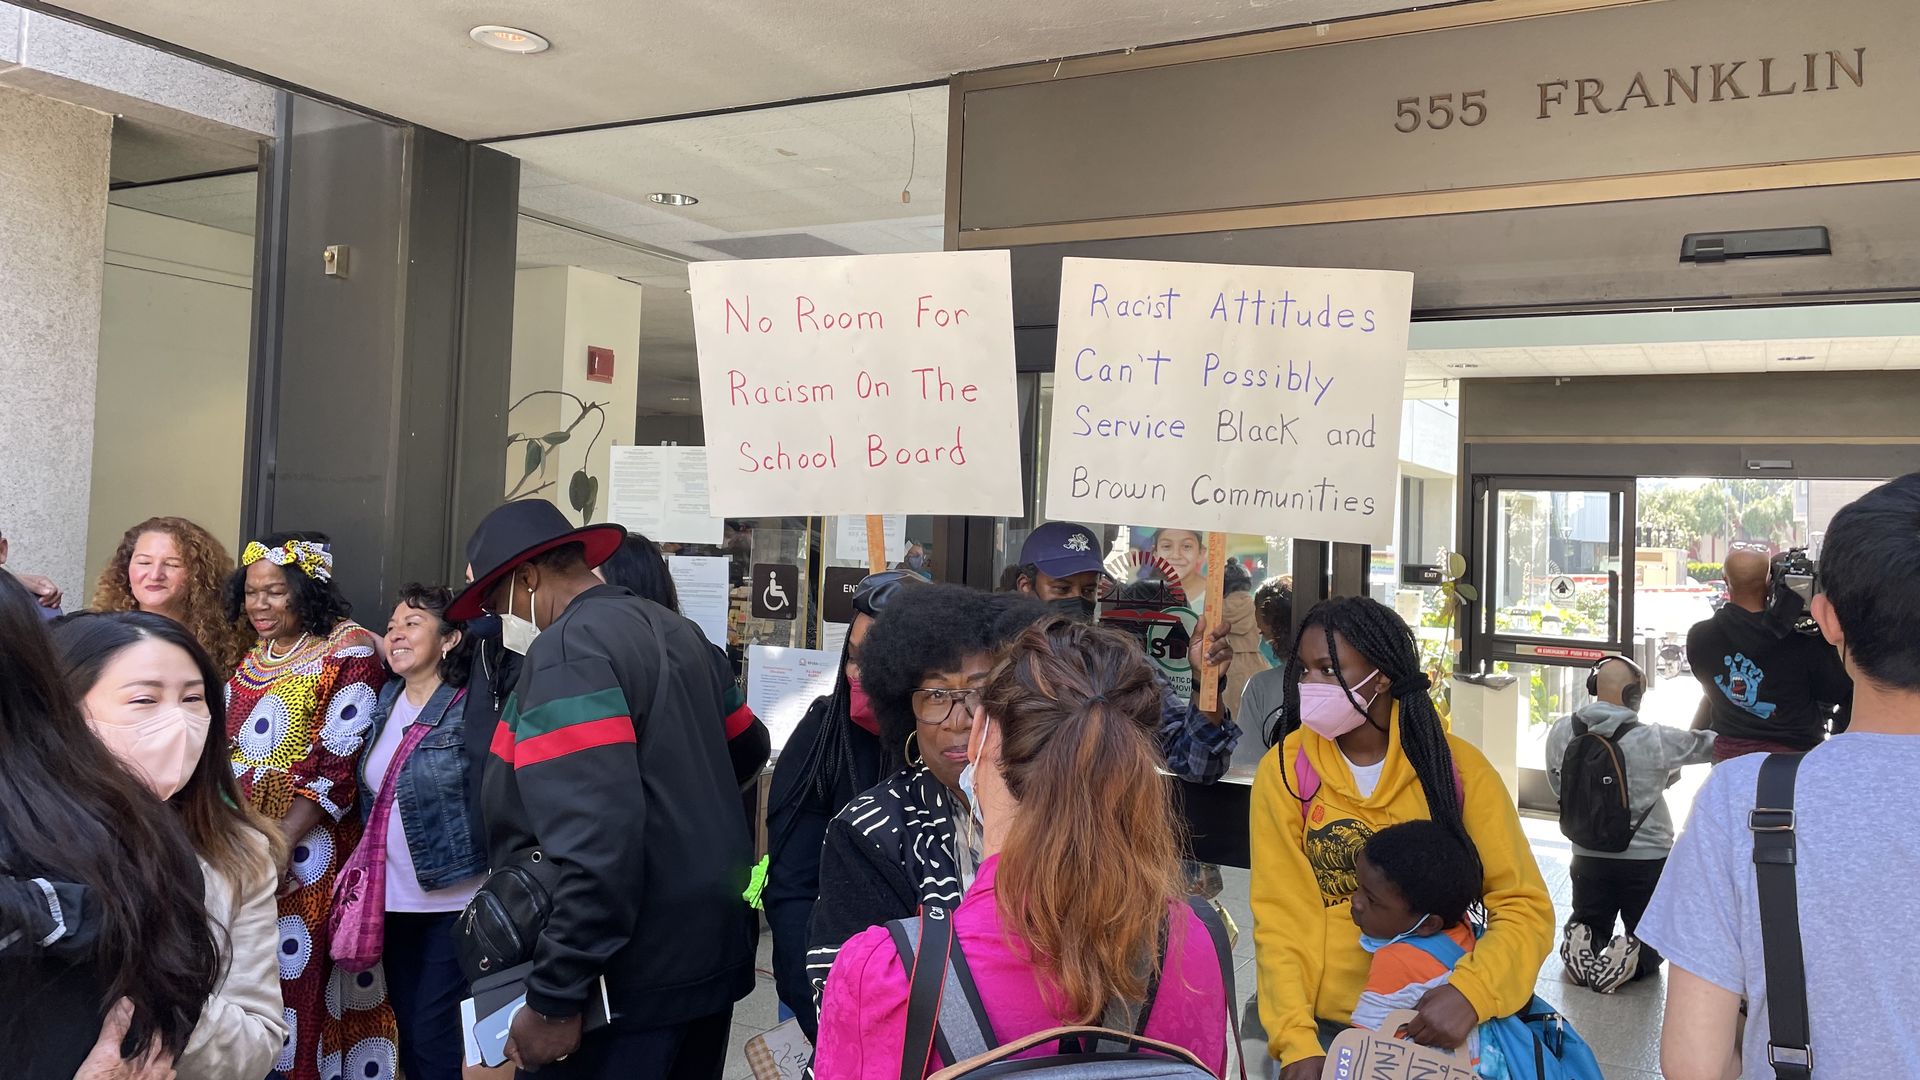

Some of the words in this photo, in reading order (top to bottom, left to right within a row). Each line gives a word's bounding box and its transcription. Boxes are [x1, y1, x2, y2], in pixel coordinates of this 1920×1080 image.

[1394, 89, 1487, 133] 555
[1536, 47, 1866, 119] FRANKLIN
[726, 295, 772, 334] No
[796, 296, 883, 332] Room
[917, 295, 969, 328] For
[1090, 284, 1181, 320] Racist
[1209, 289, 1375, 332] Attitudes
[728, 370, 833, 406] Racism
[857, 371, 889, 398] On
[912, 366, 977, 402] The
[1075, 348, 1171, 385] Can't
[1203, 353, 1334, 406] Possibly
[739, 435, 836, 472] School
[868, 426, 966, 467] Board
[1073, 404, 1185, 439] Service
[1217, 409, 1299, 445] Black
[1327, 413, 1376, 448] and
[1072, 465, 1166, 502] Brown
[1191, 474, 1375, 516] Communities
[1337, 1048, 1351, 1080] EXP
